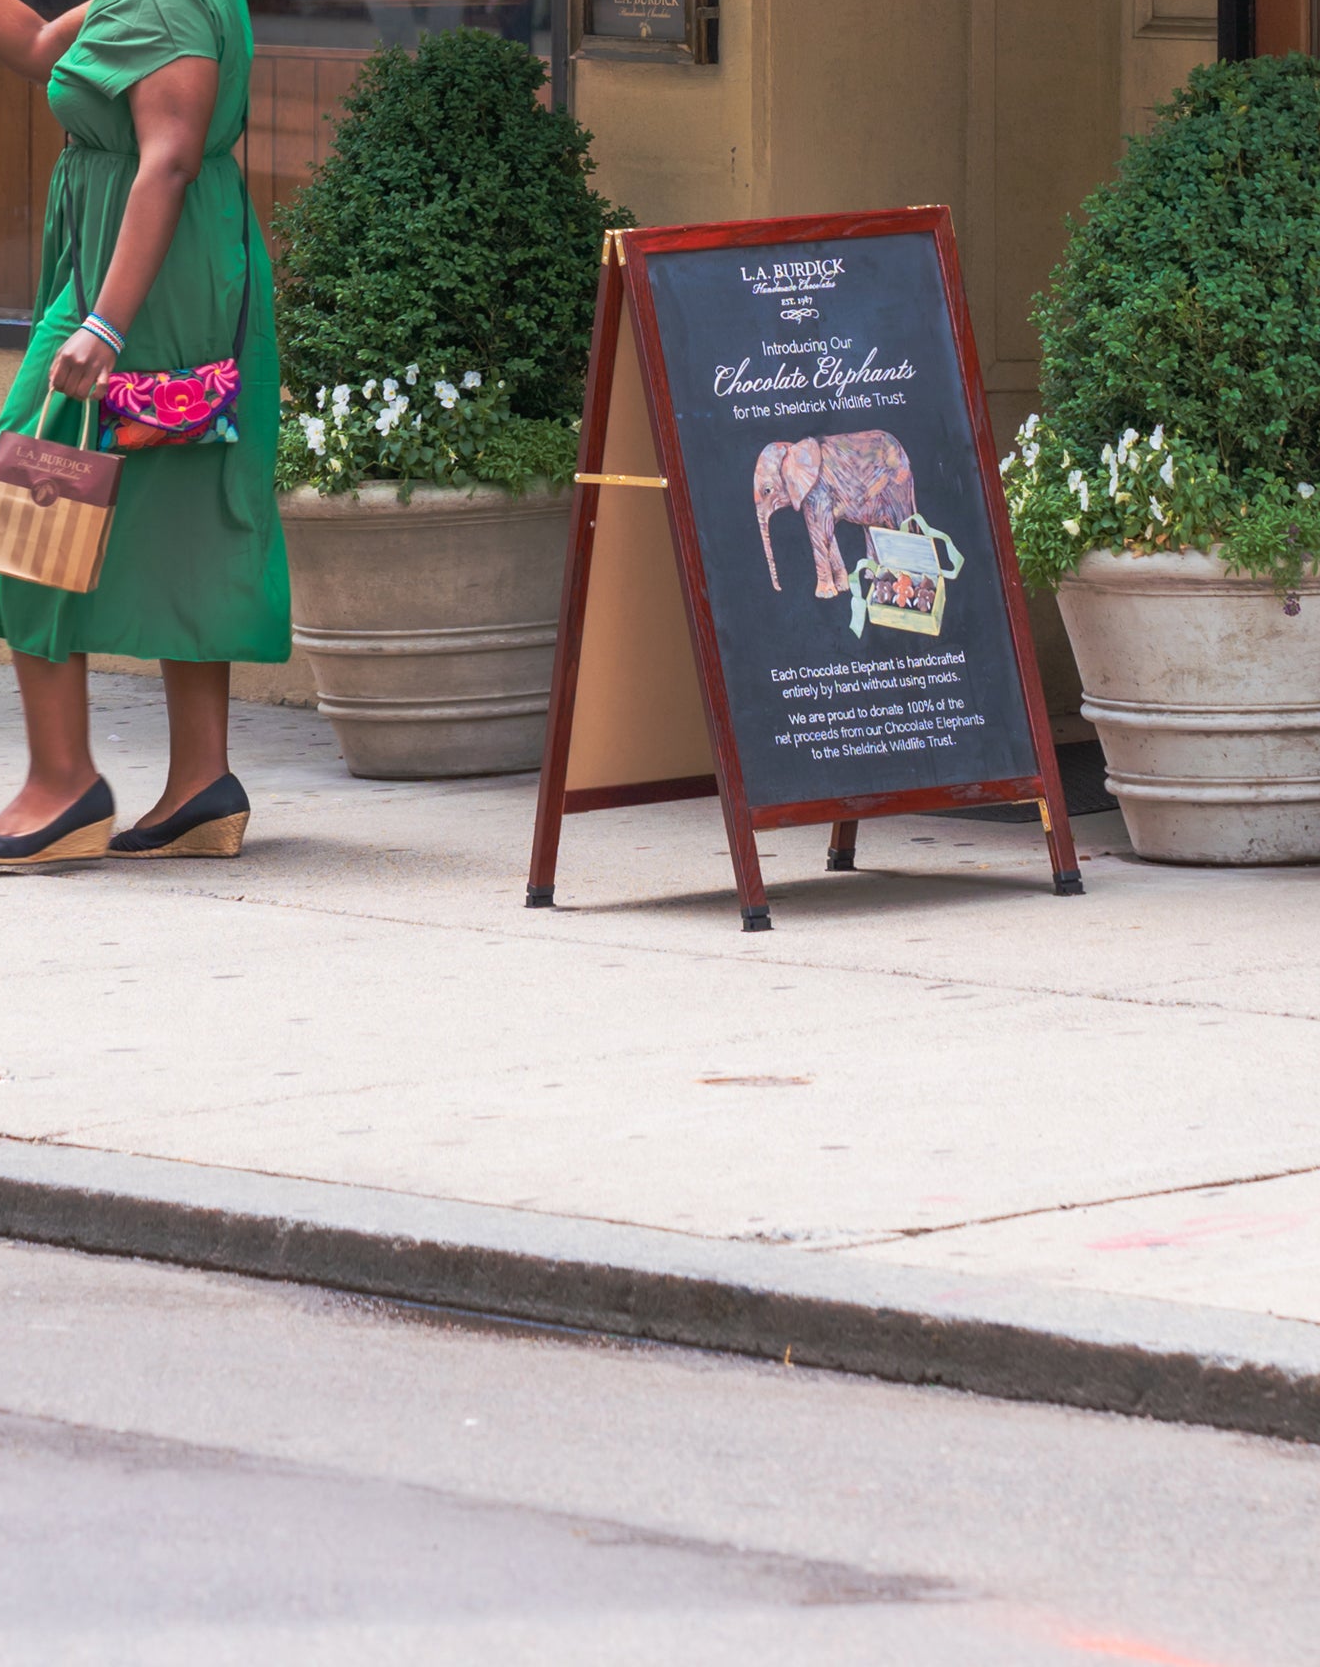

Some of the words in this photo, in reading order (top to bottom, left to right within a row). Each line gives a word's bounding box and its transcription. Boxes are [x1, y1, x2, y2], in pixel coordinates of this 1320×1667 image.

[740, 266, 771, 281] L.A.
[773, 258, 845, 278] BURDICK
[762, 337, 828, 356] Introducing
[830, 336, 853, 350] Our
[714, 357, 809, 397] Chocolate
[813, 346, 917, 398] Elephants
[733, 405, 750, 419] for
[751, 403, 771, 418] the
[774, 398, 827, 416] Sheldrick
[829, 394, 872, 411] Wildlife
[872, 391, 906, 407] Trust
[40, 453, 93, 474] BURDICK
[771, 667, 797, 682] Each
[799, 661, 849, 679] Chocolate
[851, 658, 895, 676] Elephant
[896, 656, 906, 669] is
[906, 651, 966, 668] handcrafted
[782, 681, 818, 699] entirely
[820, 681, 833, 699] by
[834, 679, 860, 694] hand
[861, 676, 898, 691] without
[899, 674, 926, 689] using
[927, 670, 961, 684] molds.
[788, 713, 807, 725] We
[808, 712, 826, 723] are
[827, 707, 856, 724] proud
[857, 706, 868, 718] to
[869, 703, 904, 717] donate
[907, 699, 935, 713] 100%
[936, 698, 946, 710] of
[948, 697, 965, 710] the
[775, 731, 792, 746] net
[793, 727, 839, 748] proceeds
[840, 725, 864, 738] from
[866, 725, 883, 736] our
[884, 718, 934, 734] Chocolate
[936, 714, 985, 731] Elephants
[811, 747, 822, 760] to
[824, 745, 840, 758] the
[842, 740, 888, 756] Sheldrick
[889, 736, 926, 752] Wildlife
[927, 733, 957, 748] Trust.
